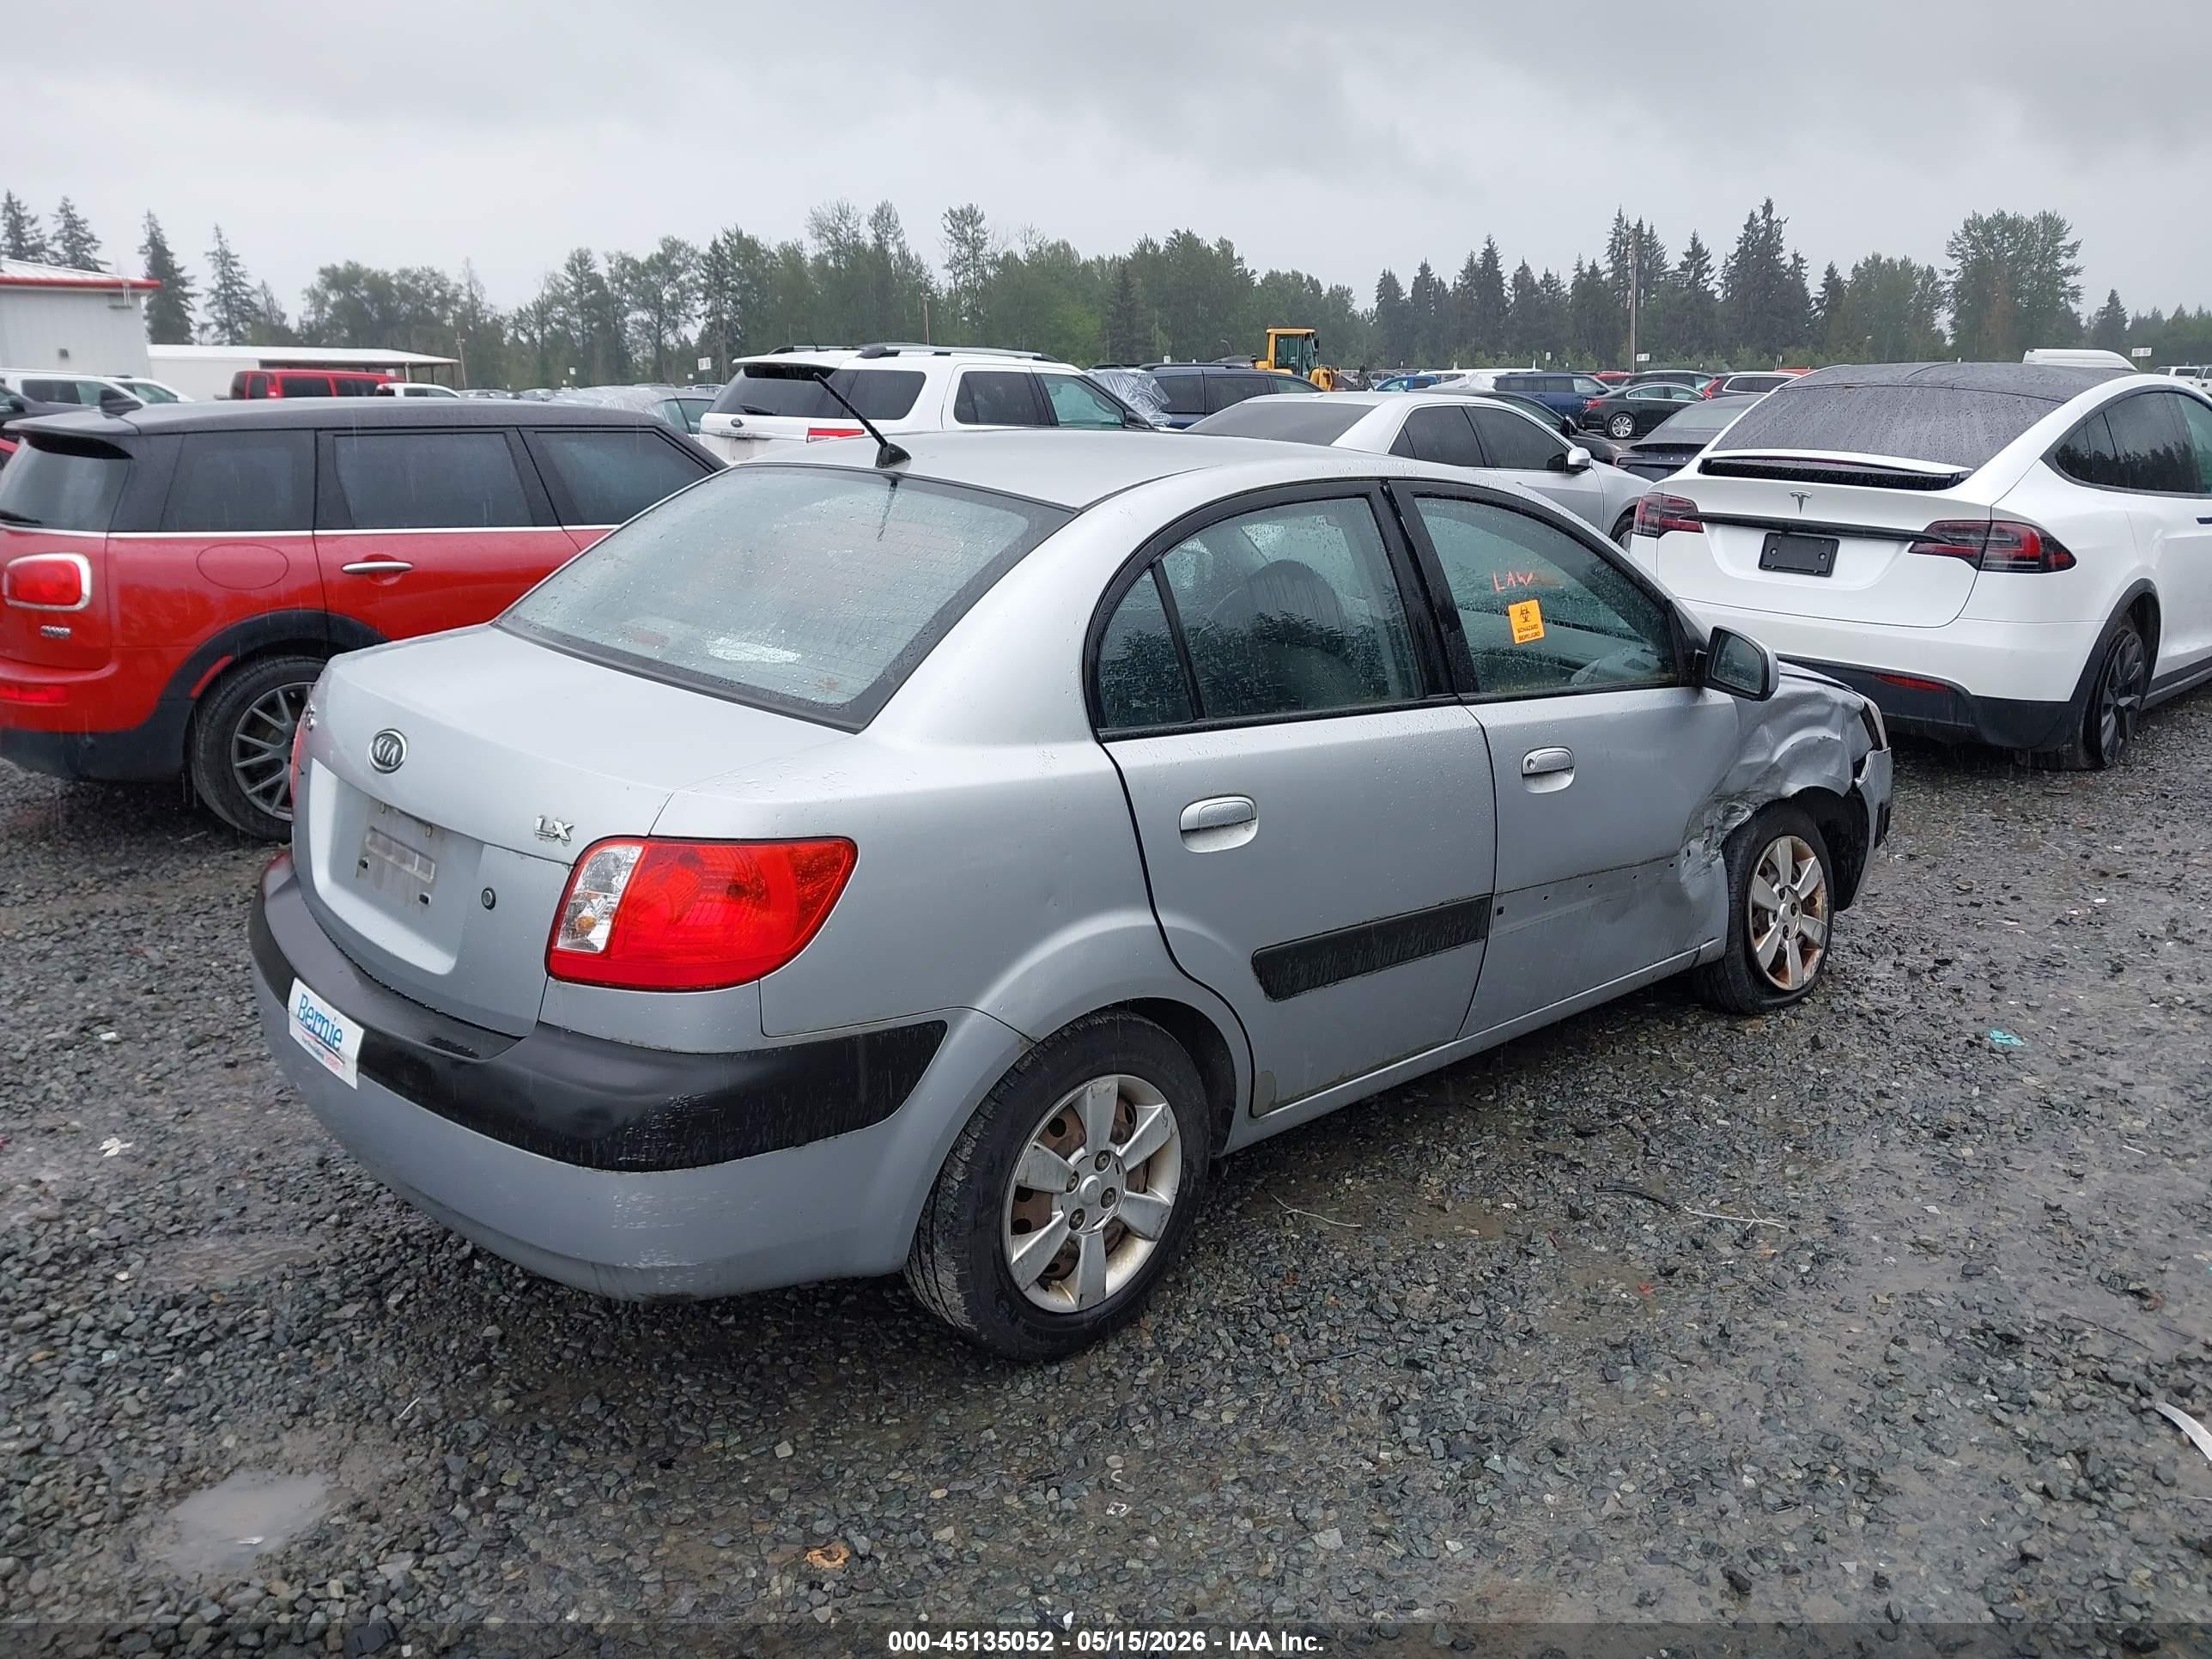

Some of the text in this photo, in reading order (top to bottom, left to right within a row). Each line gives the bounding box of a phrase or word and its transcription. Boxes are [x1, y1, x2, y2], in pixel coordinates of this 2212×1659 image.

[1492, 570, 1534, 592] LAW
[372, 736, 399, 766] KIA
[535, 816, 574, 842] LX
[296, 994, 343, 1052] Bernie
